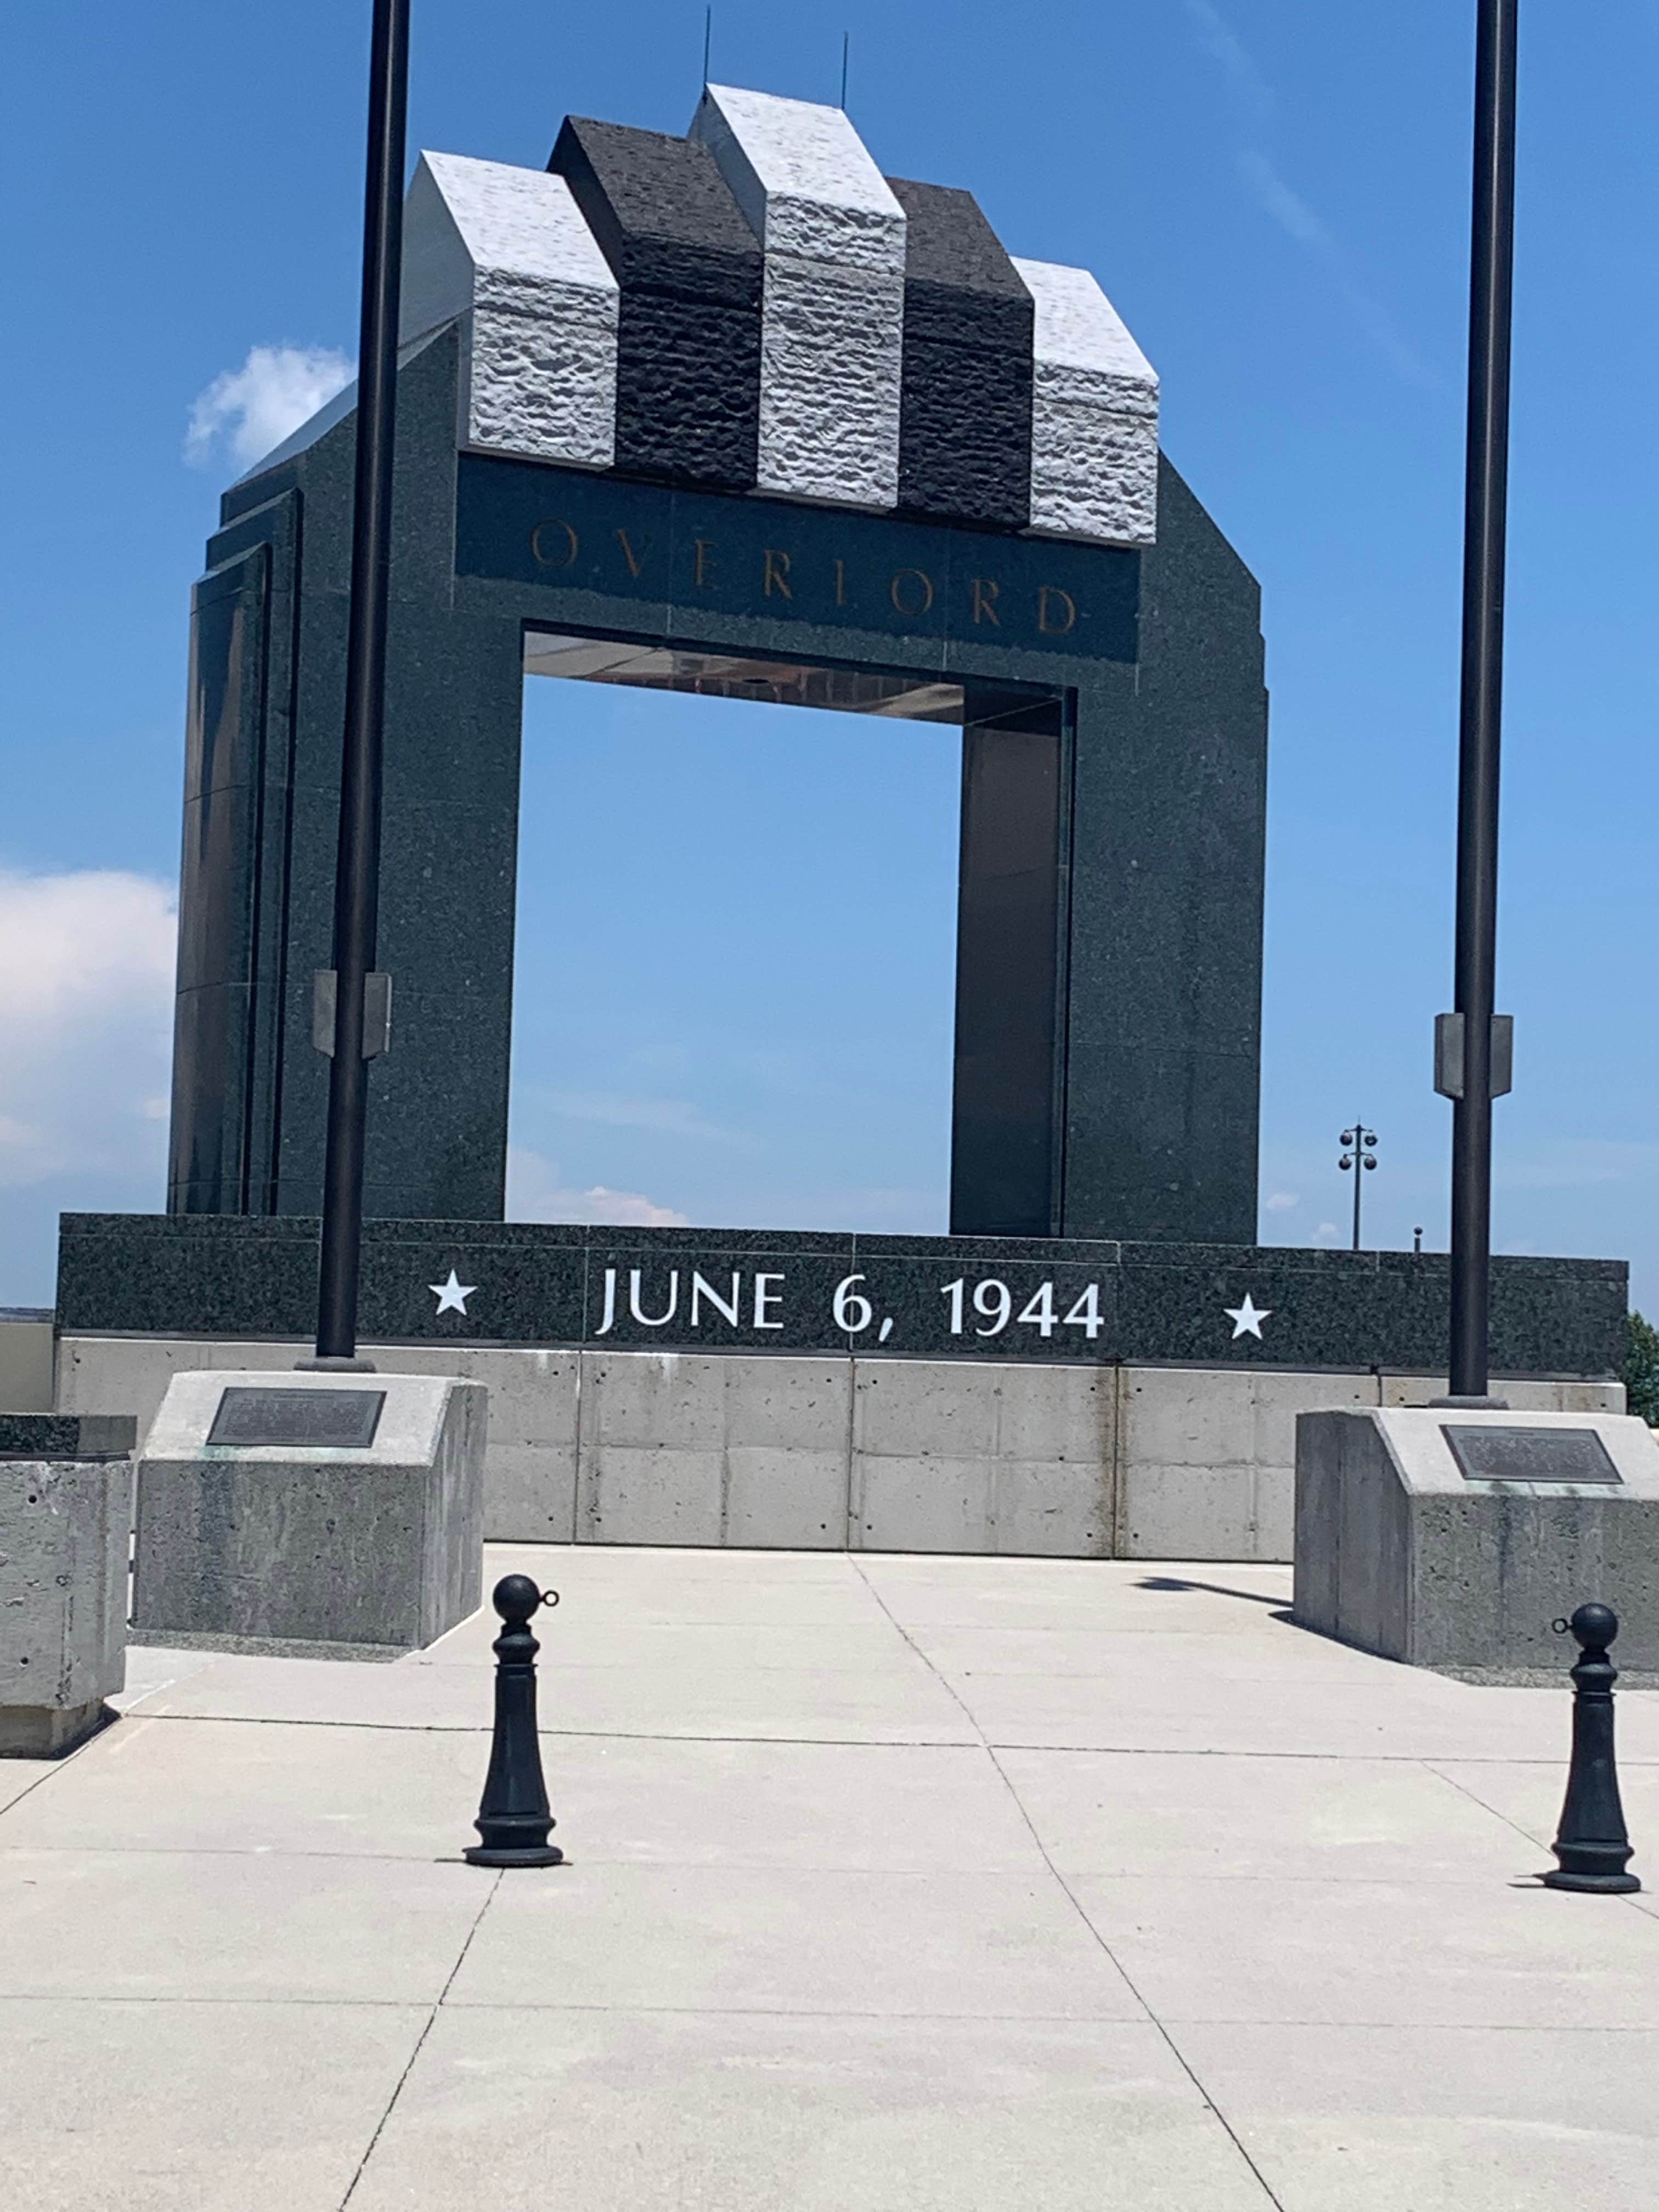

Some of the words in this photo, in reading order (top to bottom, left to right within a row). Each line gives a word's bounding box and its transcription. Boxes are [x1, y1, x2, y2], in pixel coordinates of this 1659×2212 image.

[595, 1268, 785, 1335] JUNE
[833, 1274, 893, 1342] 6,
[940, 1278, 1104, 1339] 1944
